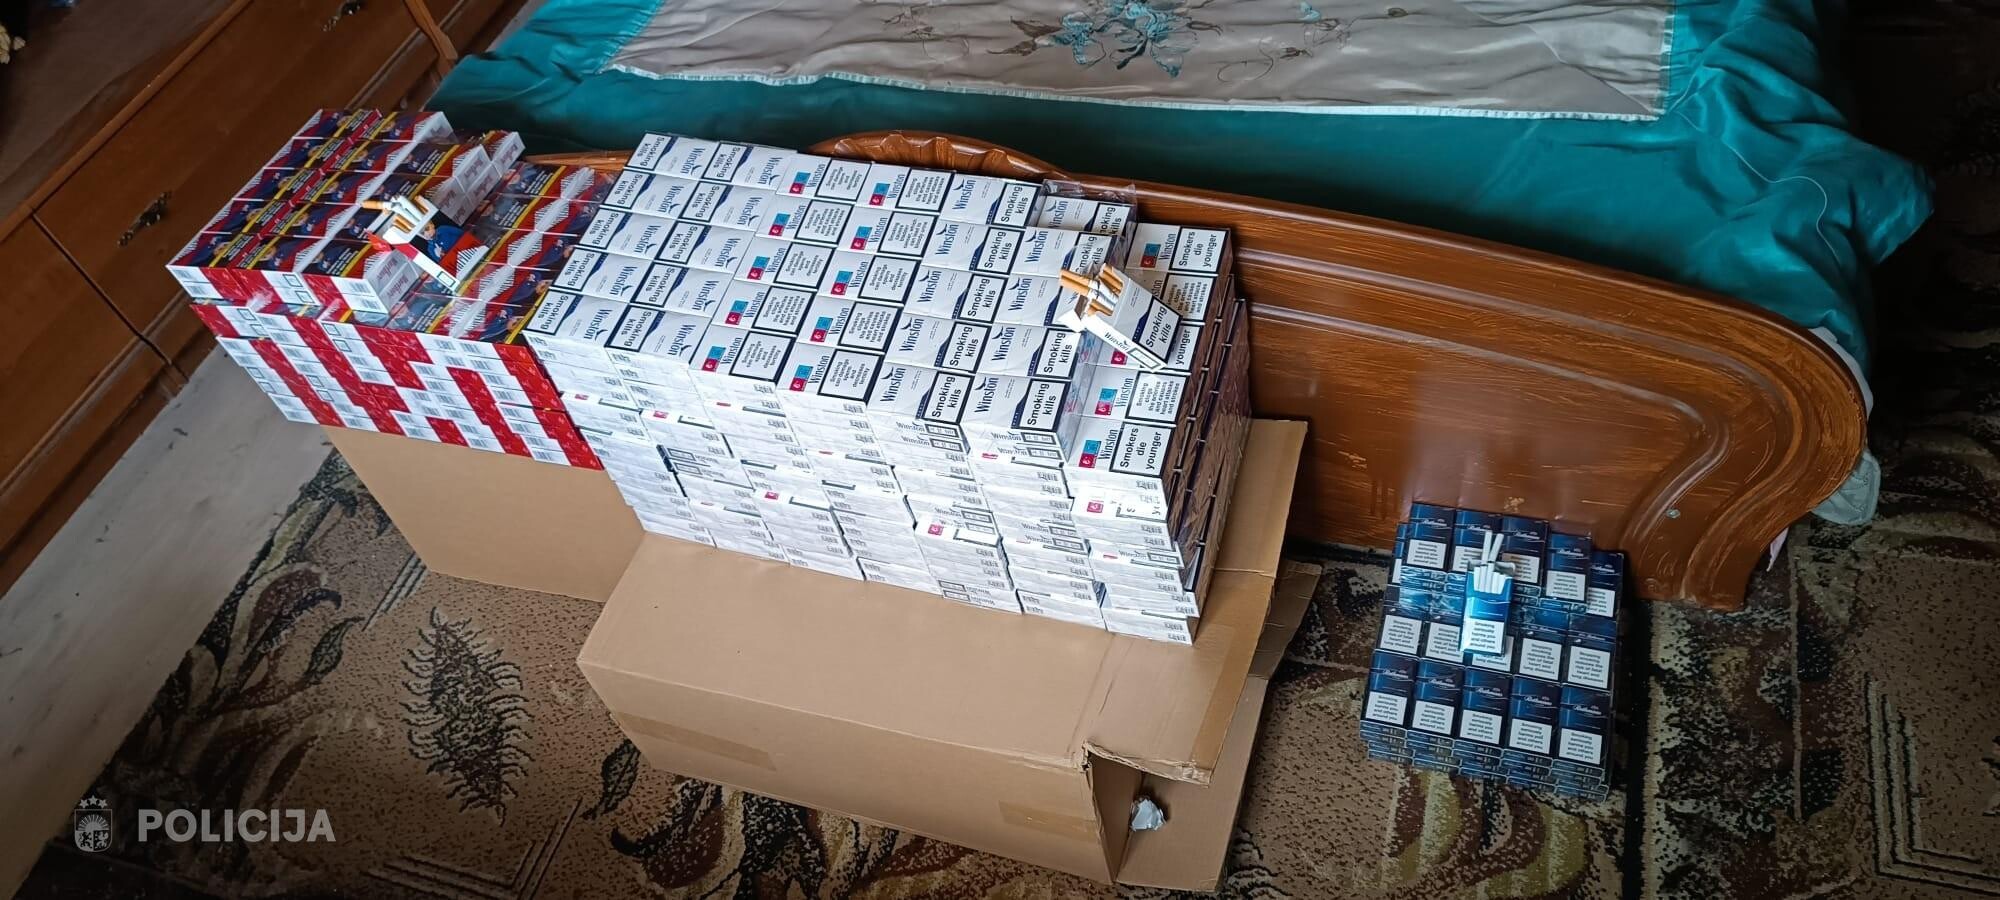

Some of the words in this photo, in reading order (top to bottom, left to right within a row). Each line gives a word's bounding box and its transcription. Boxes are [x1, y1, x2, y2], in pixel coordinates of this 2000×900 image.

[637, 144, 651, 157] kills
[640, 138, 664, 166] Smoking
[680, 148, 706, 174] Winston
[714, 154, 727, 168] kills
[717, 147, 740, 178] Smoking
[758, 157, 783, 185] Winston
[807, 163, 826, 188] Winston
[614, 181, 629, 195] kills
[618, 174, 642, 205] Smoking
[658, 186, 684, 213] Winston
[692, 192, 706, 208] kills
[887, 174, 906, 199] Winston
[952, 180, 977, 210] Winston
[696, 186, 720, 217] Smoking
[737, 197, 762, 226] Winston
[1001, 186, 1022, 222] Smoking
[1015, 197, 1029, 214] kills
[590, 220, 604, 234] kills
[592, 212, 618, 245] Smoking
[786, 205, 806, 230] Winston
[869, 217, 888, 243] Winston
[1100, 207, 1116, 232] oking
[634, 225, 661, 253] Winston
[669, 234, 684, 249] kills
[672, 226, 698, 260] Smoking
[715, 238, 740, 267] Winston
[935, 224, 959, 255] Winston
[984, 231, 1006, 268] Smoking
[998, 242, 1012, 260] kills
[1024, 231, 1048, 263] Winston
[1159, 233, 1176, 261] Winston
[1179, 232, 1196, 266] Smokers
[1195, 244, 1203, 256] die
[1203, 234, 1217, 267] younger
[565, 260, 580, 276] kills
[568, 253, 595, 286] Smoking
[765, 248, 786, 273] Winston
[848, 261, 867, 288] Winston
[610, 266, 638, 296] Winston
[646, 275, 660, 292] kills
[648, 268, 676, 302] Smoking
[692, 280, 720, 311] Winston
[917, 271, 942, 302] Winston
[1008, 278, 1032, 311] Winston
[538, 303, 553, 319] kills
[540, 295, 568, 330] Smoking
[744, 292, 765, 318] Winston
[968, 279, 990, 317] Smoking
[982, 290, 996, 308] kills
[584, 309, 613, 340] Winston
[621, 318, 636, 335] kills
[624, 312, 652, 347] Smoking
[828, 308, 850, 334] Winston
[900, 319, 924, 352] Winston
[1146, 306, 1167, 347] Smoking
[1158, 323, 1171, 344] kills
[668, 324, 696, 356] Winston
[721, 337, 742, 364] Winston
[950, 326, 972, 366] Smoking
[965, 338, 979, 357] kills
[992, 327, 1016, 361] Winston
[1044, 332, 1066, 373] Smoking
[1059, 344, 1073, 364] kills
[1176, 329, 1191, 365] younger
[808, 356, 830, 384] Winston
[880, 368, 906, 402] Winston
[932, 376, 955, 418] Smoking
[947, 389, 961, 408] kills
[974, 377, 999, 413] Winston
[1115, 378, 1134, 407] Winston
[1027, 384, 1050, 425] Smoking
[1042, 395, 1057, 415] kills
[1099, 429, 1118, 459] Winston
[1120, 428, 1139, 468] Smokers
[1137, 442, 1147, 456] die
[1146, 432, 1162, 470] younger
